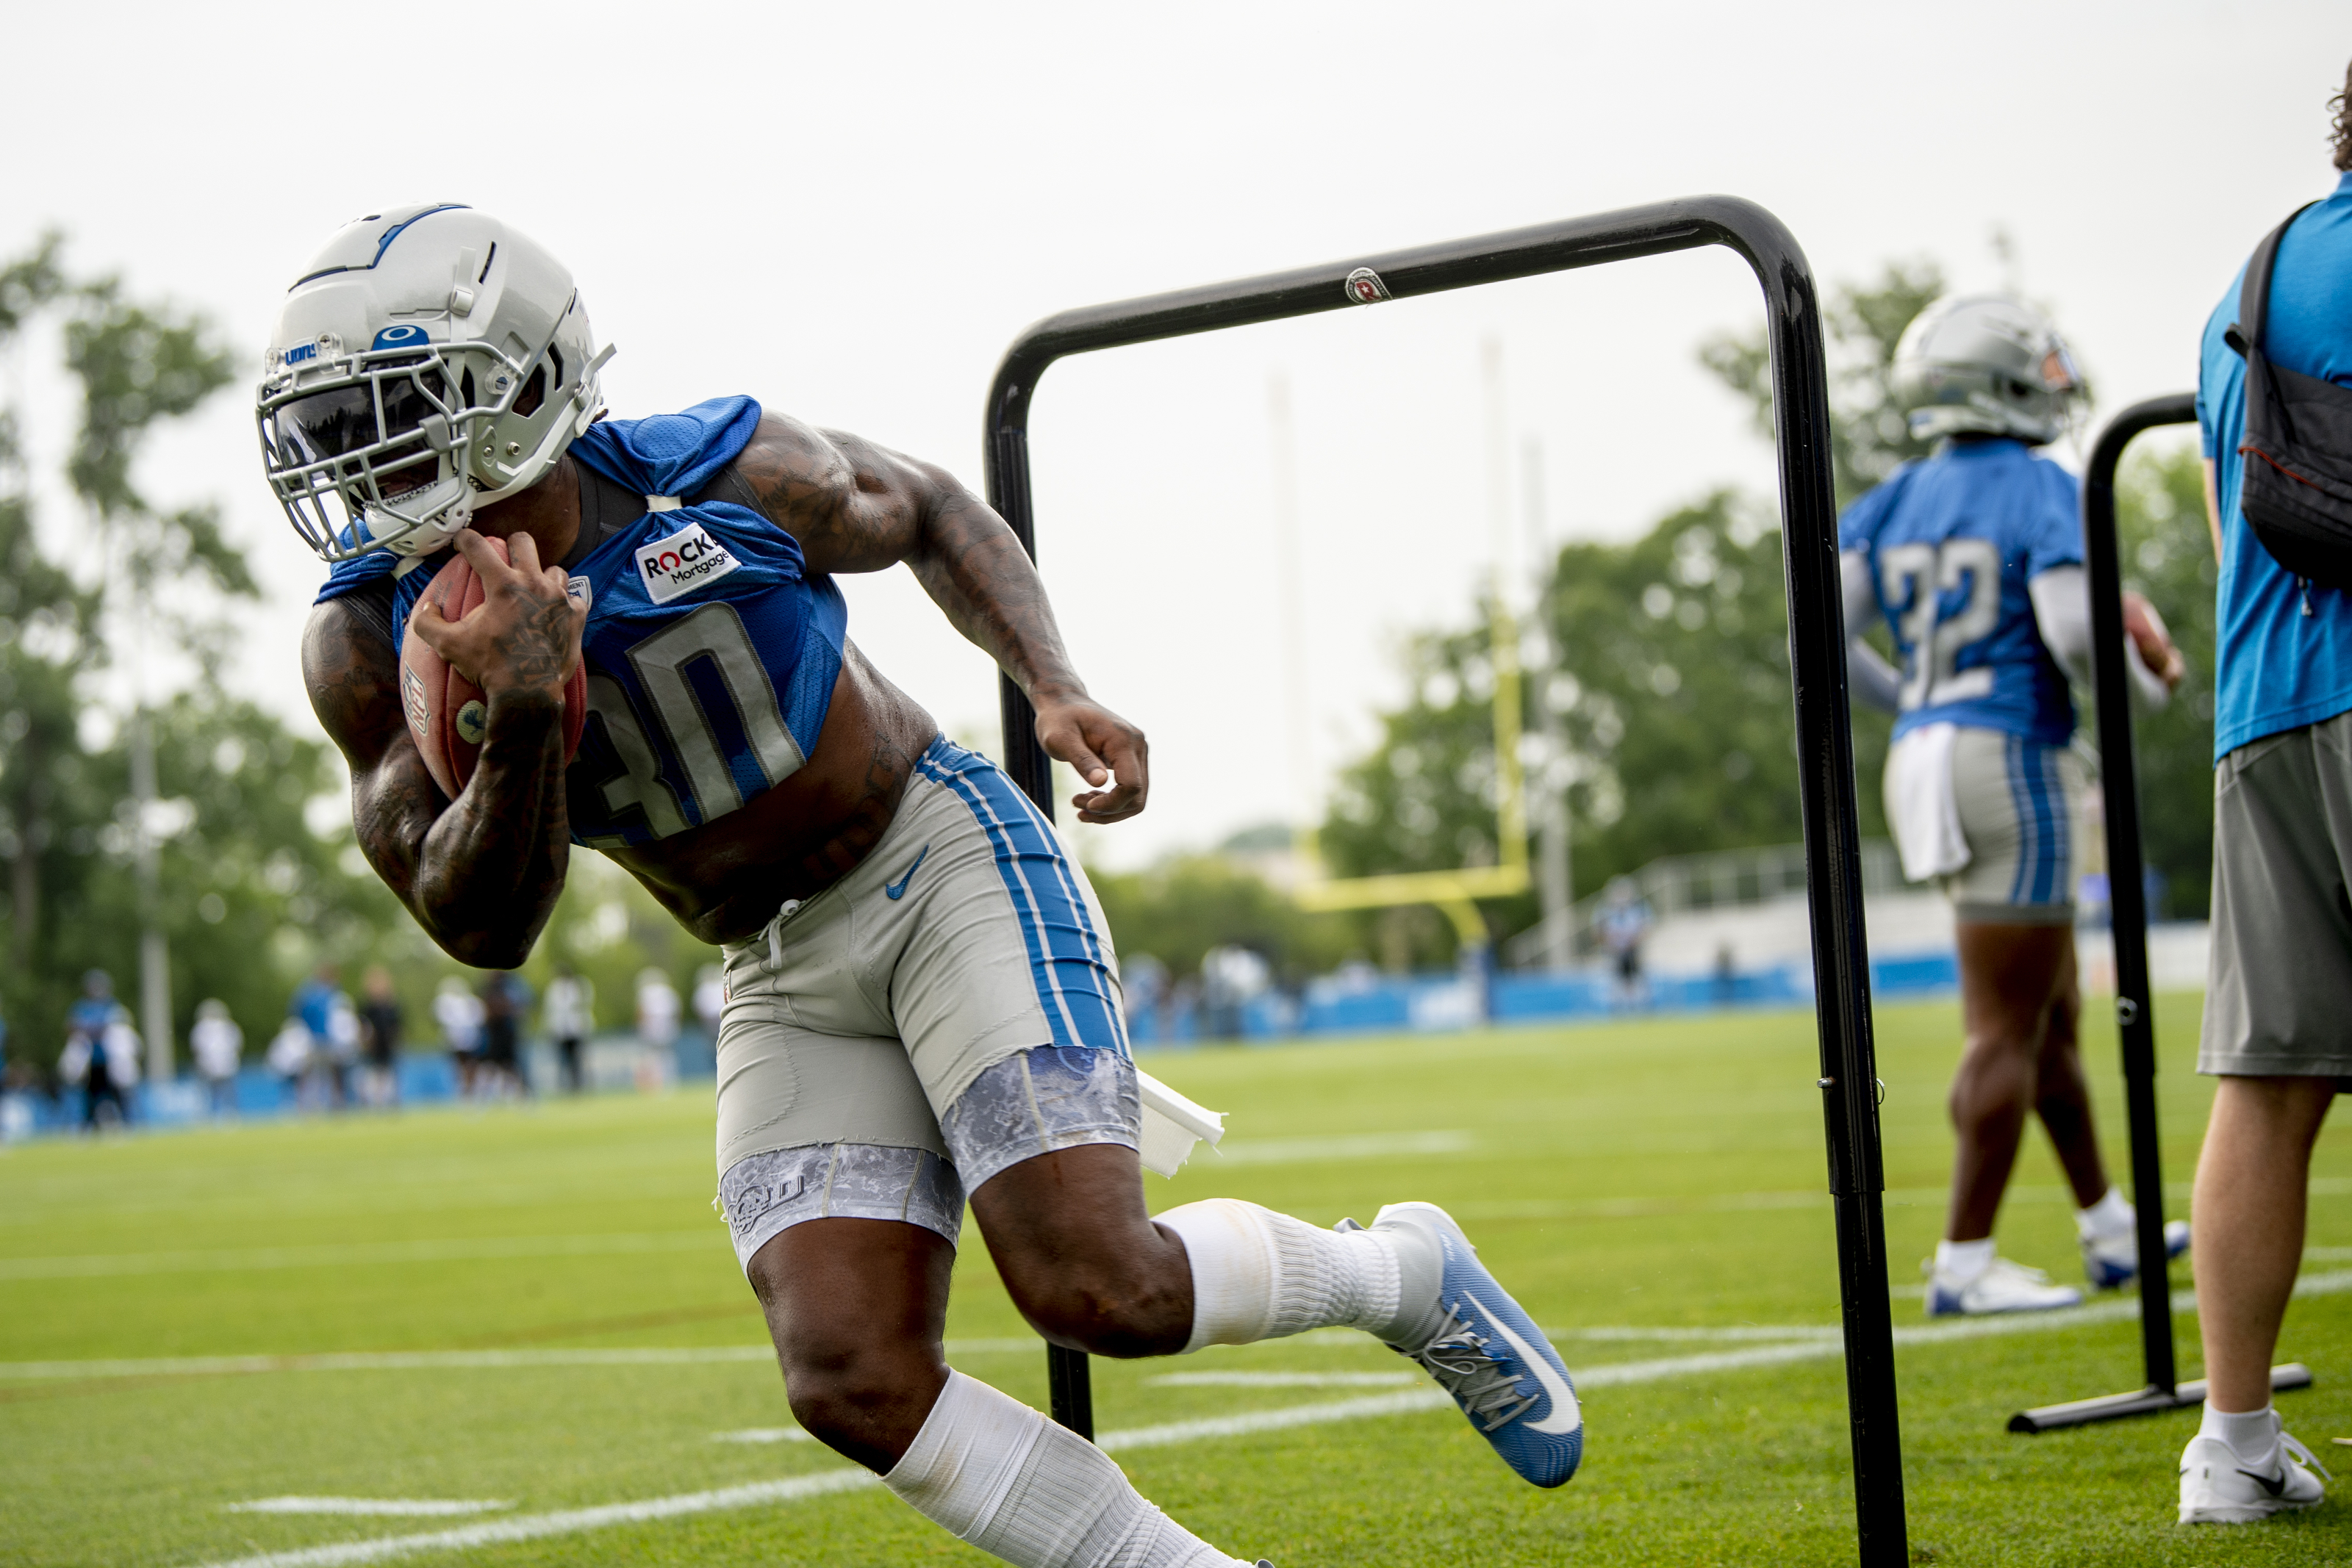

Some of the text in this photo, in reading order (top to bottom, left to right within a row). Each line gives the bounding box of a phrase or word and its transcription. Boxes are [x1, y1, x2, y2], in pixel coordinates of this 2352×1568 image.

[644, 532, 717, 579] ROCK
[670, 550, 729, 585] Mortgage
[1879, 539, 2001, 711] 32
[412, 684, 426, 730] NFL
[575, 601, 807, 849] 30
